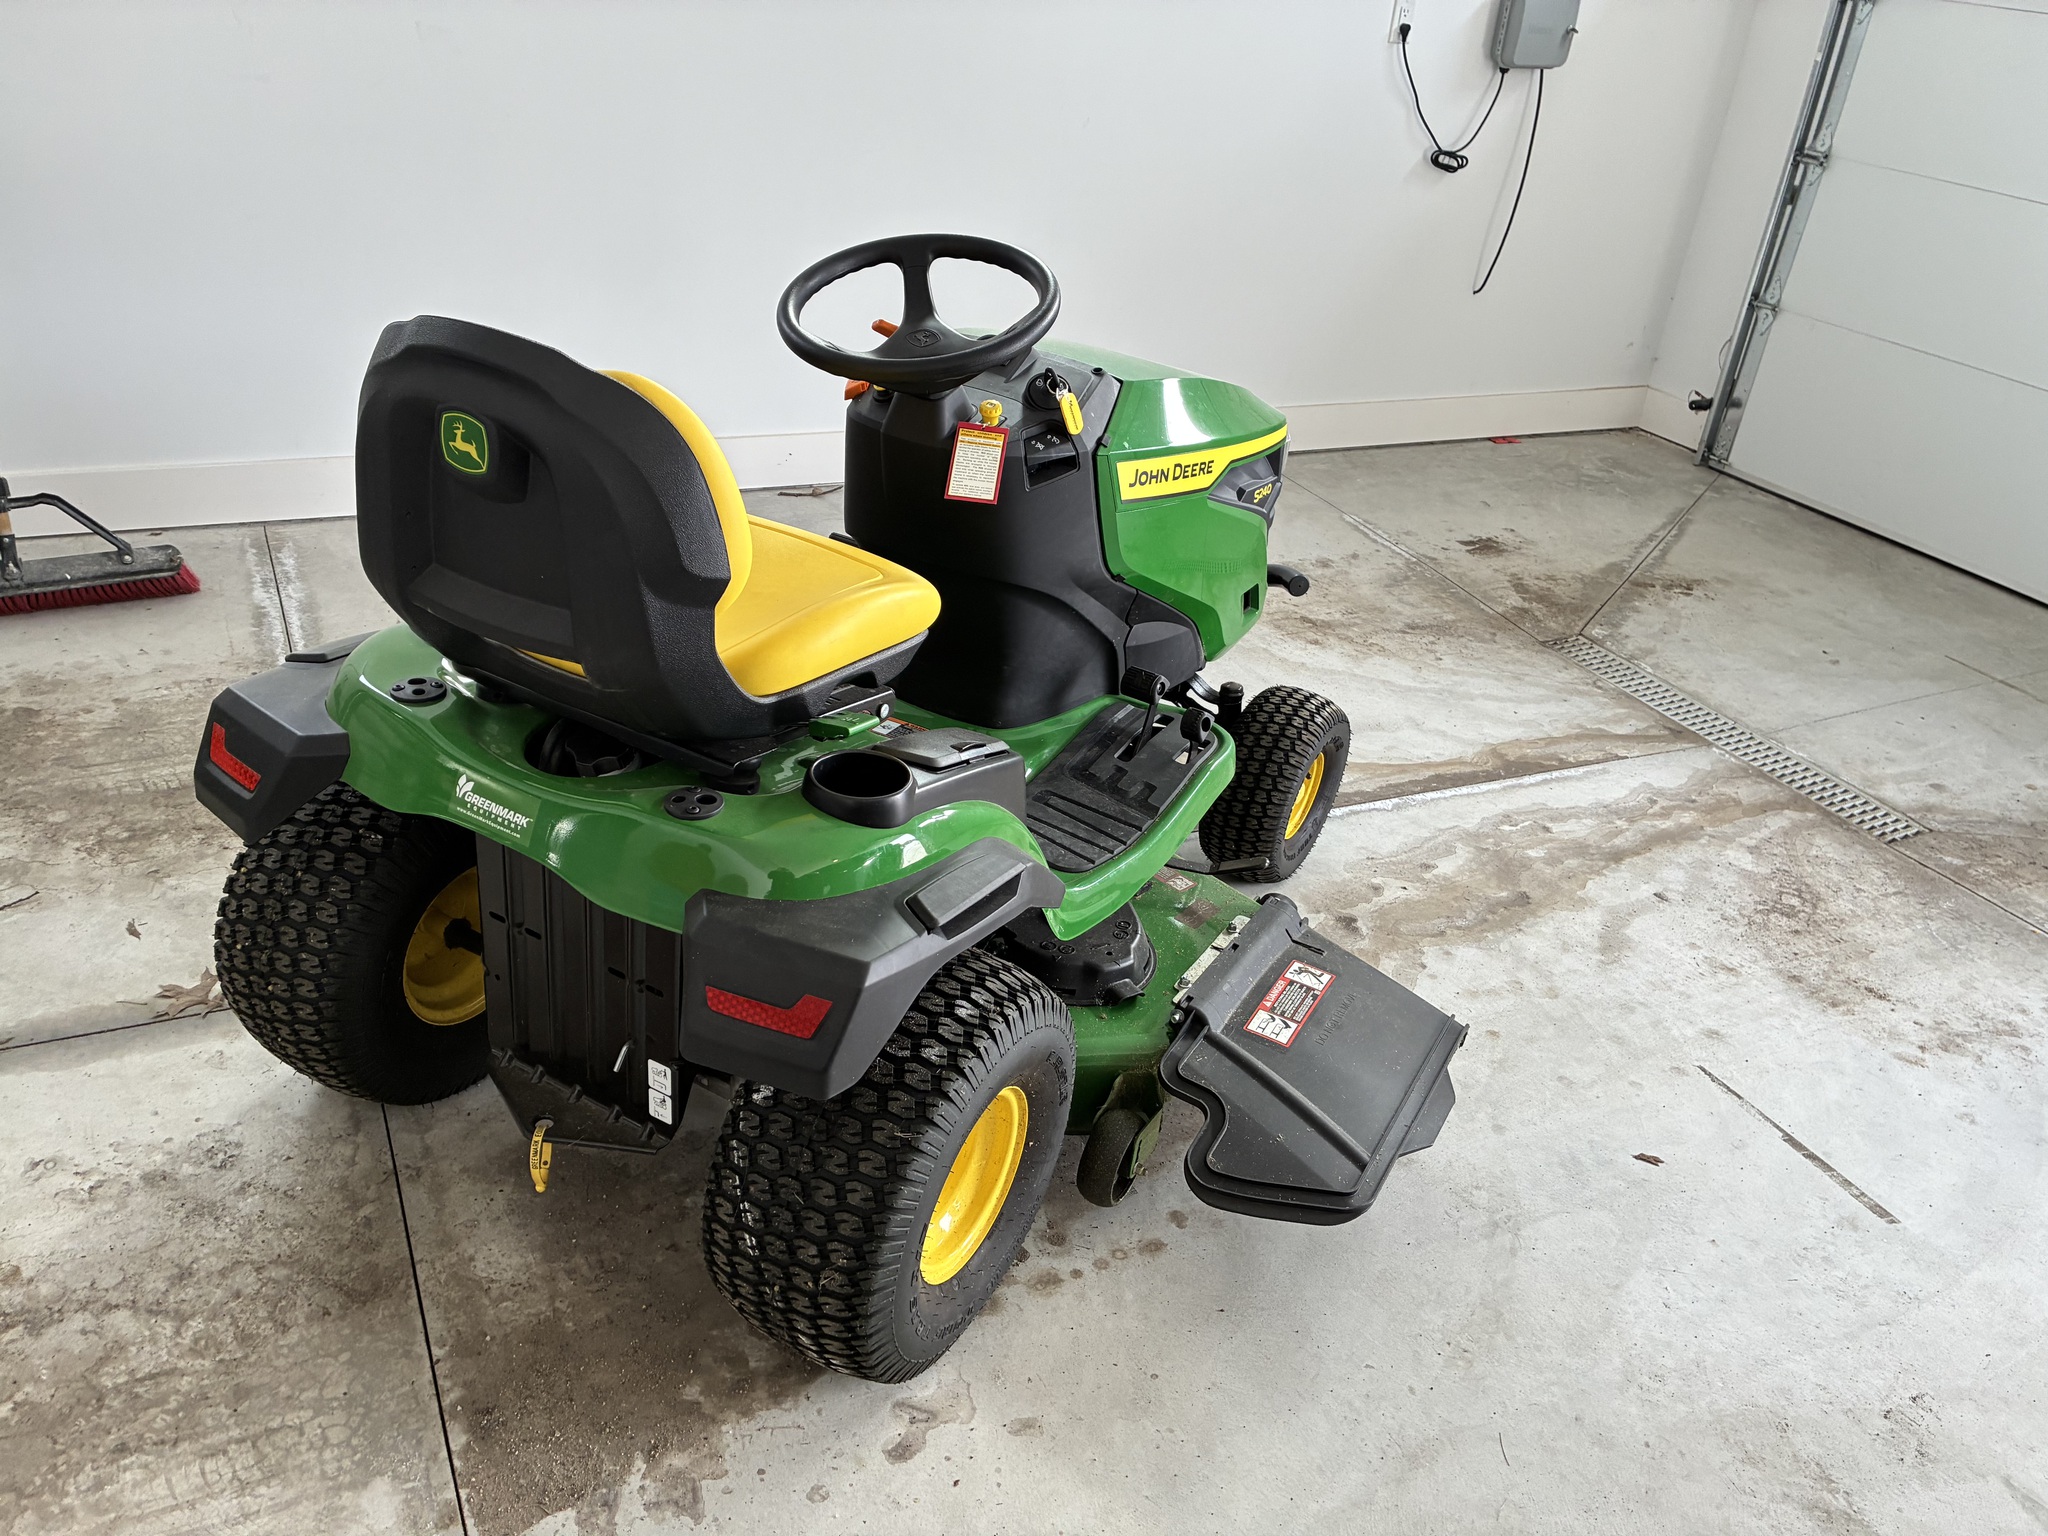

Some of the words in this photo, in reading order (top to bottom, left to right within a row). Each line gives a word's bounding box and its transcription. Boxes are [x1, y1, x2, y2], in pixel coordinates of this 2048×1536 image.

[1128, 467, 1170, 488] JOHN
[1172, 459, 1215, 481] DEERE
[1253, 482, 1273, 504] S240
[1265, 979, 1287, 1003] DANGER
